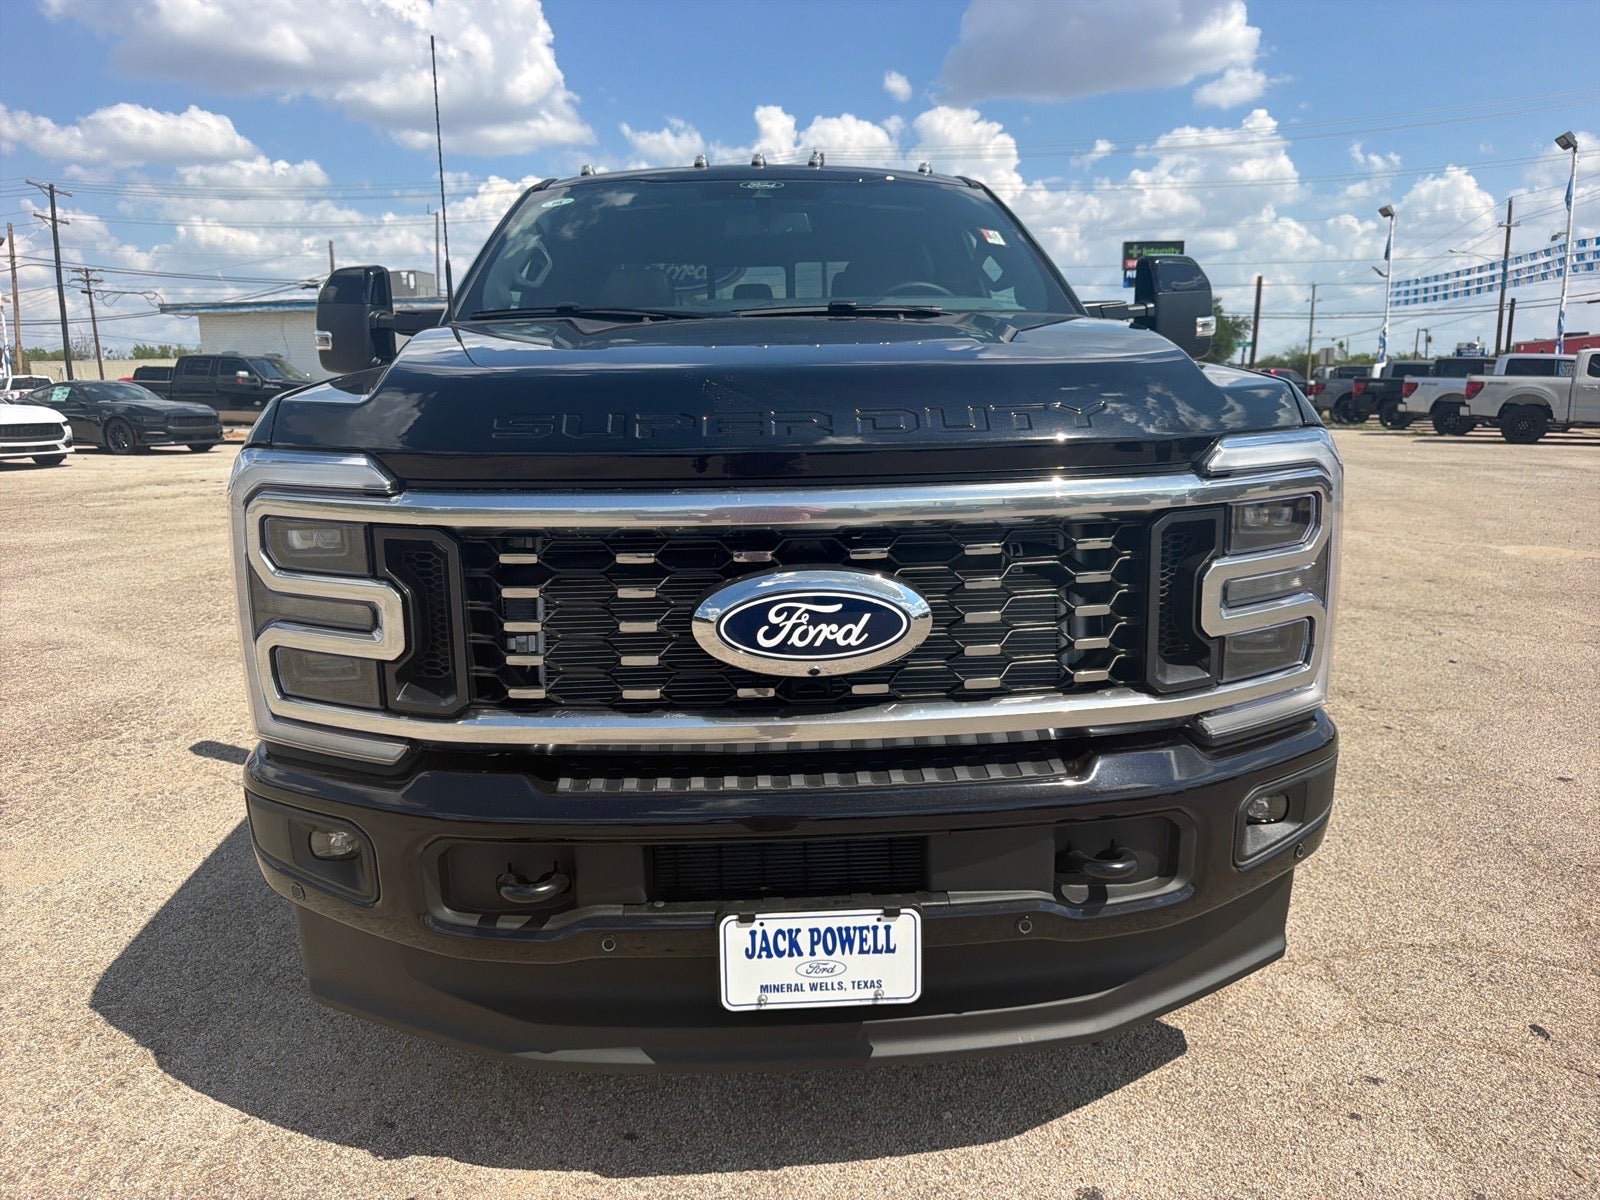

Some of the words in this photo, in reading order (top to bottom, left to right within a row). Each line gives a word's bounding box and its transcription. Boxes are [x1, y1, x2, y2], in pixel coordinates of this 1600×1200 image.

[491, 409, 834, 440] SUPER
[855, 400, 1107, 434] DUTY
[756, 602, 872, 648] Ford
[744, 927, 802, 960] JACK
[808, 924, 897, 957] POWELL
[805, 962, 837, 975] Ford
[759, 982, 806, 995] MINERAL
[808, 980, 847, 992] WELLS,
[850, 979, 883, 990] TEXAS
